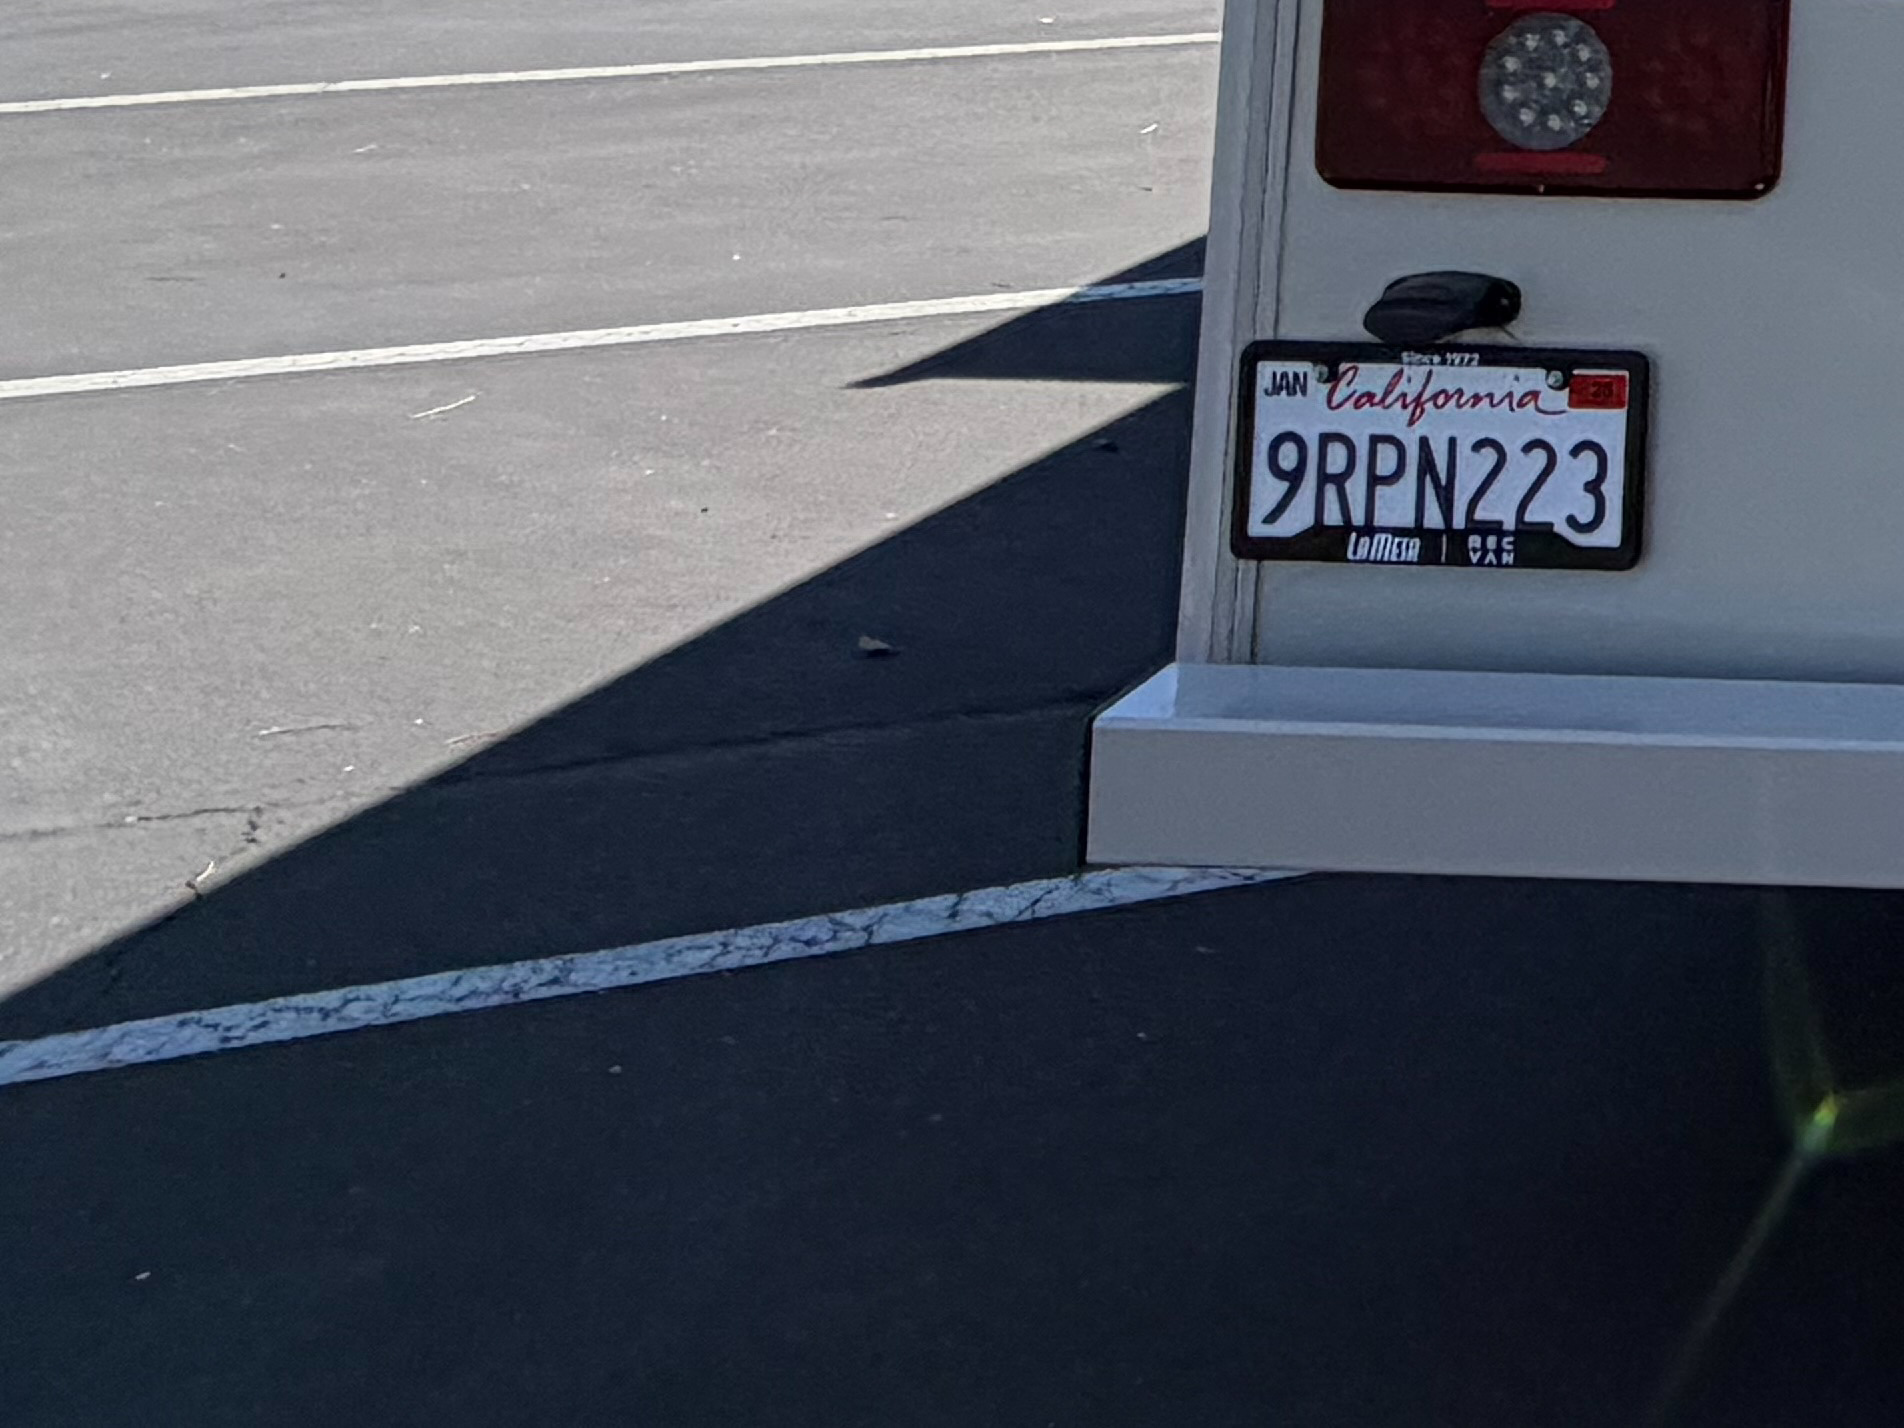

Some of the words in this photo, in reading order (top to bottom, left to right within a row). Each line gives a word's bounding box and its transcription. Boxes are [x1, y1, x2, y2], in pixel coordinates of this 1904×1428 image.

[1263, 370, 1308, 398] JAN
[1326, 364, 1568, 426] California
[1260, 429, 1609, 534] 9RPN223
